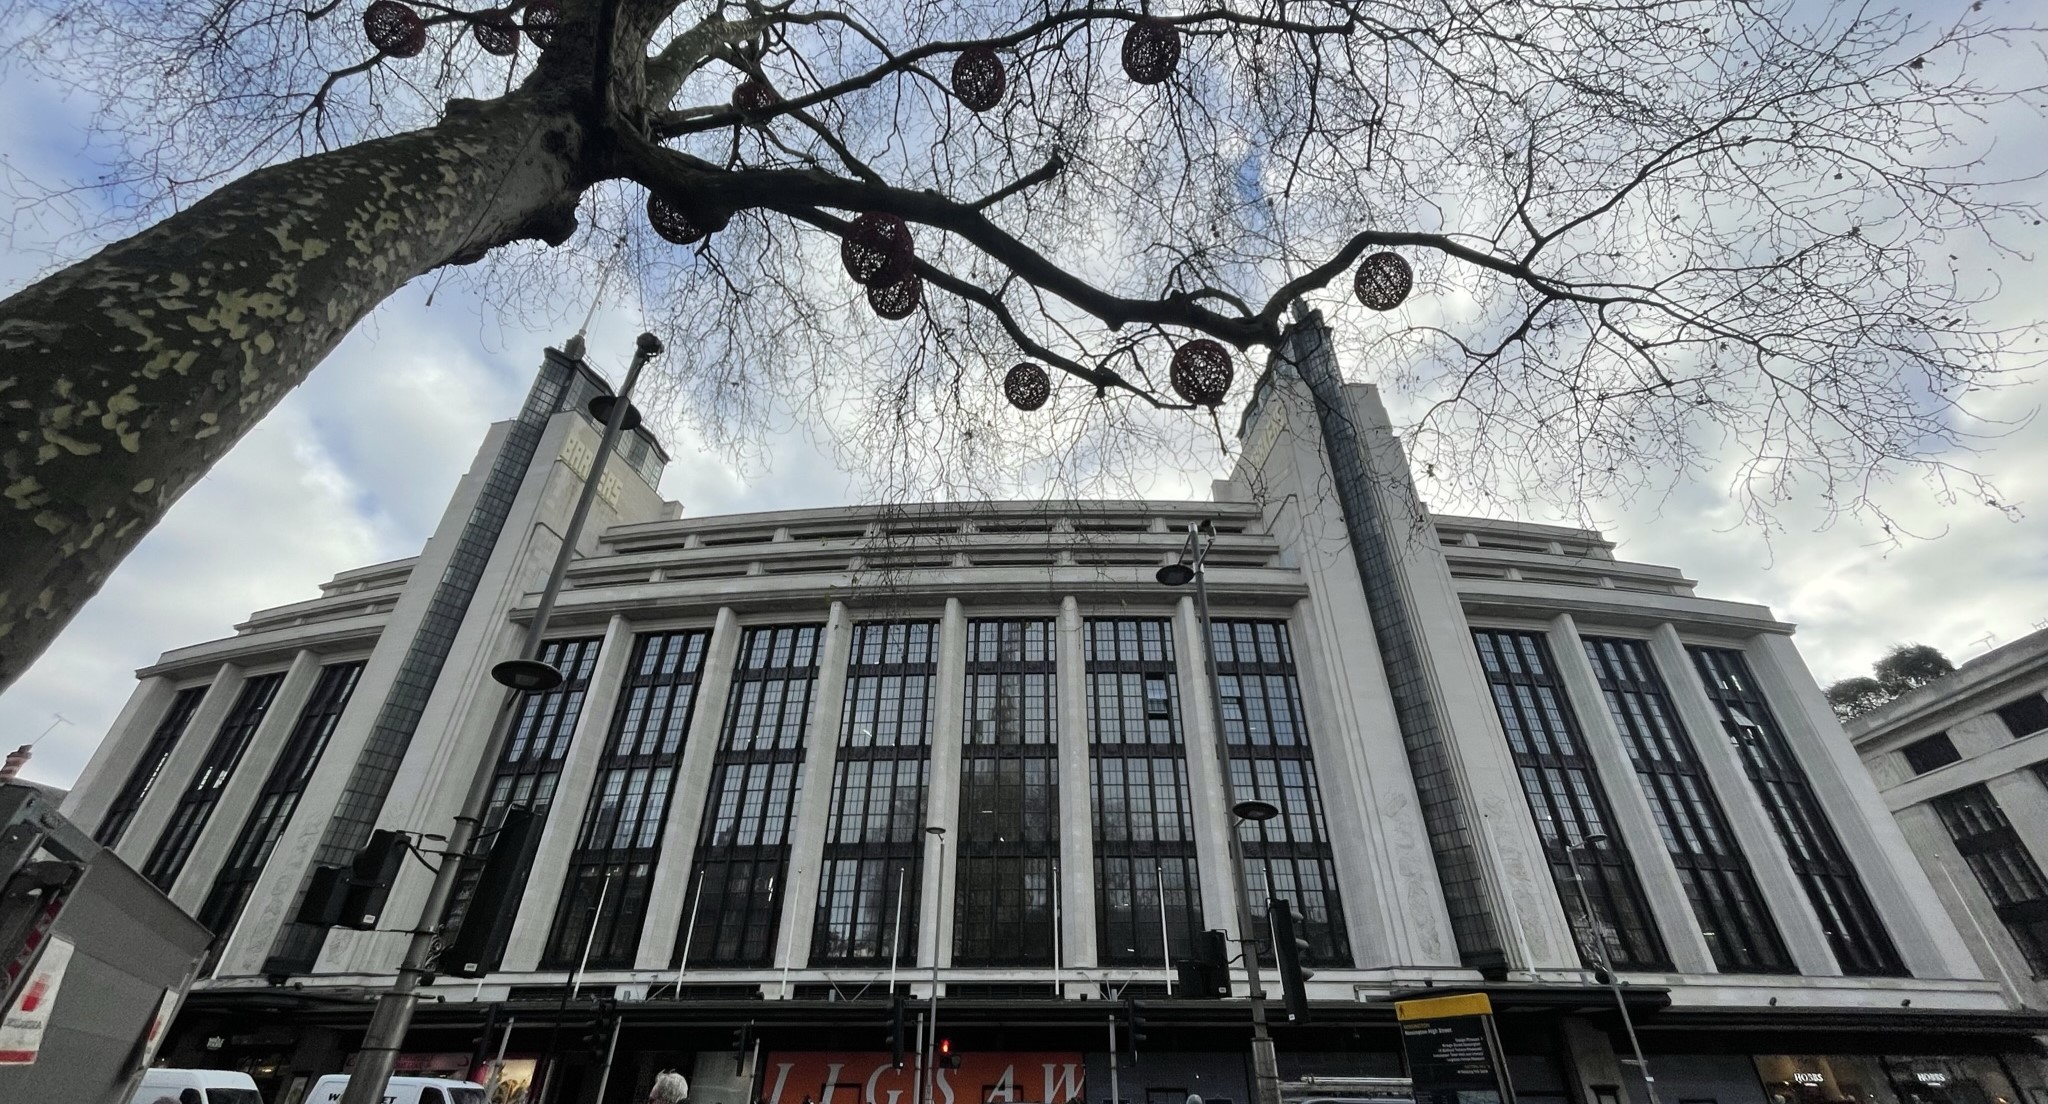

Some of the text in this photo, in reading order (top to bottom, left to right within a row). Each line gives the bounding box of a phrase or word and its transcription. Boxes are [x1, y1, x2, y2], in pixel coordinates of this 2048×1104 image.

[560, 437, 623, 507] BARERS
[1794, 1072, 1824, 1084] HOBBS
[1917, 1072, 1946, 1083] HOBBS
